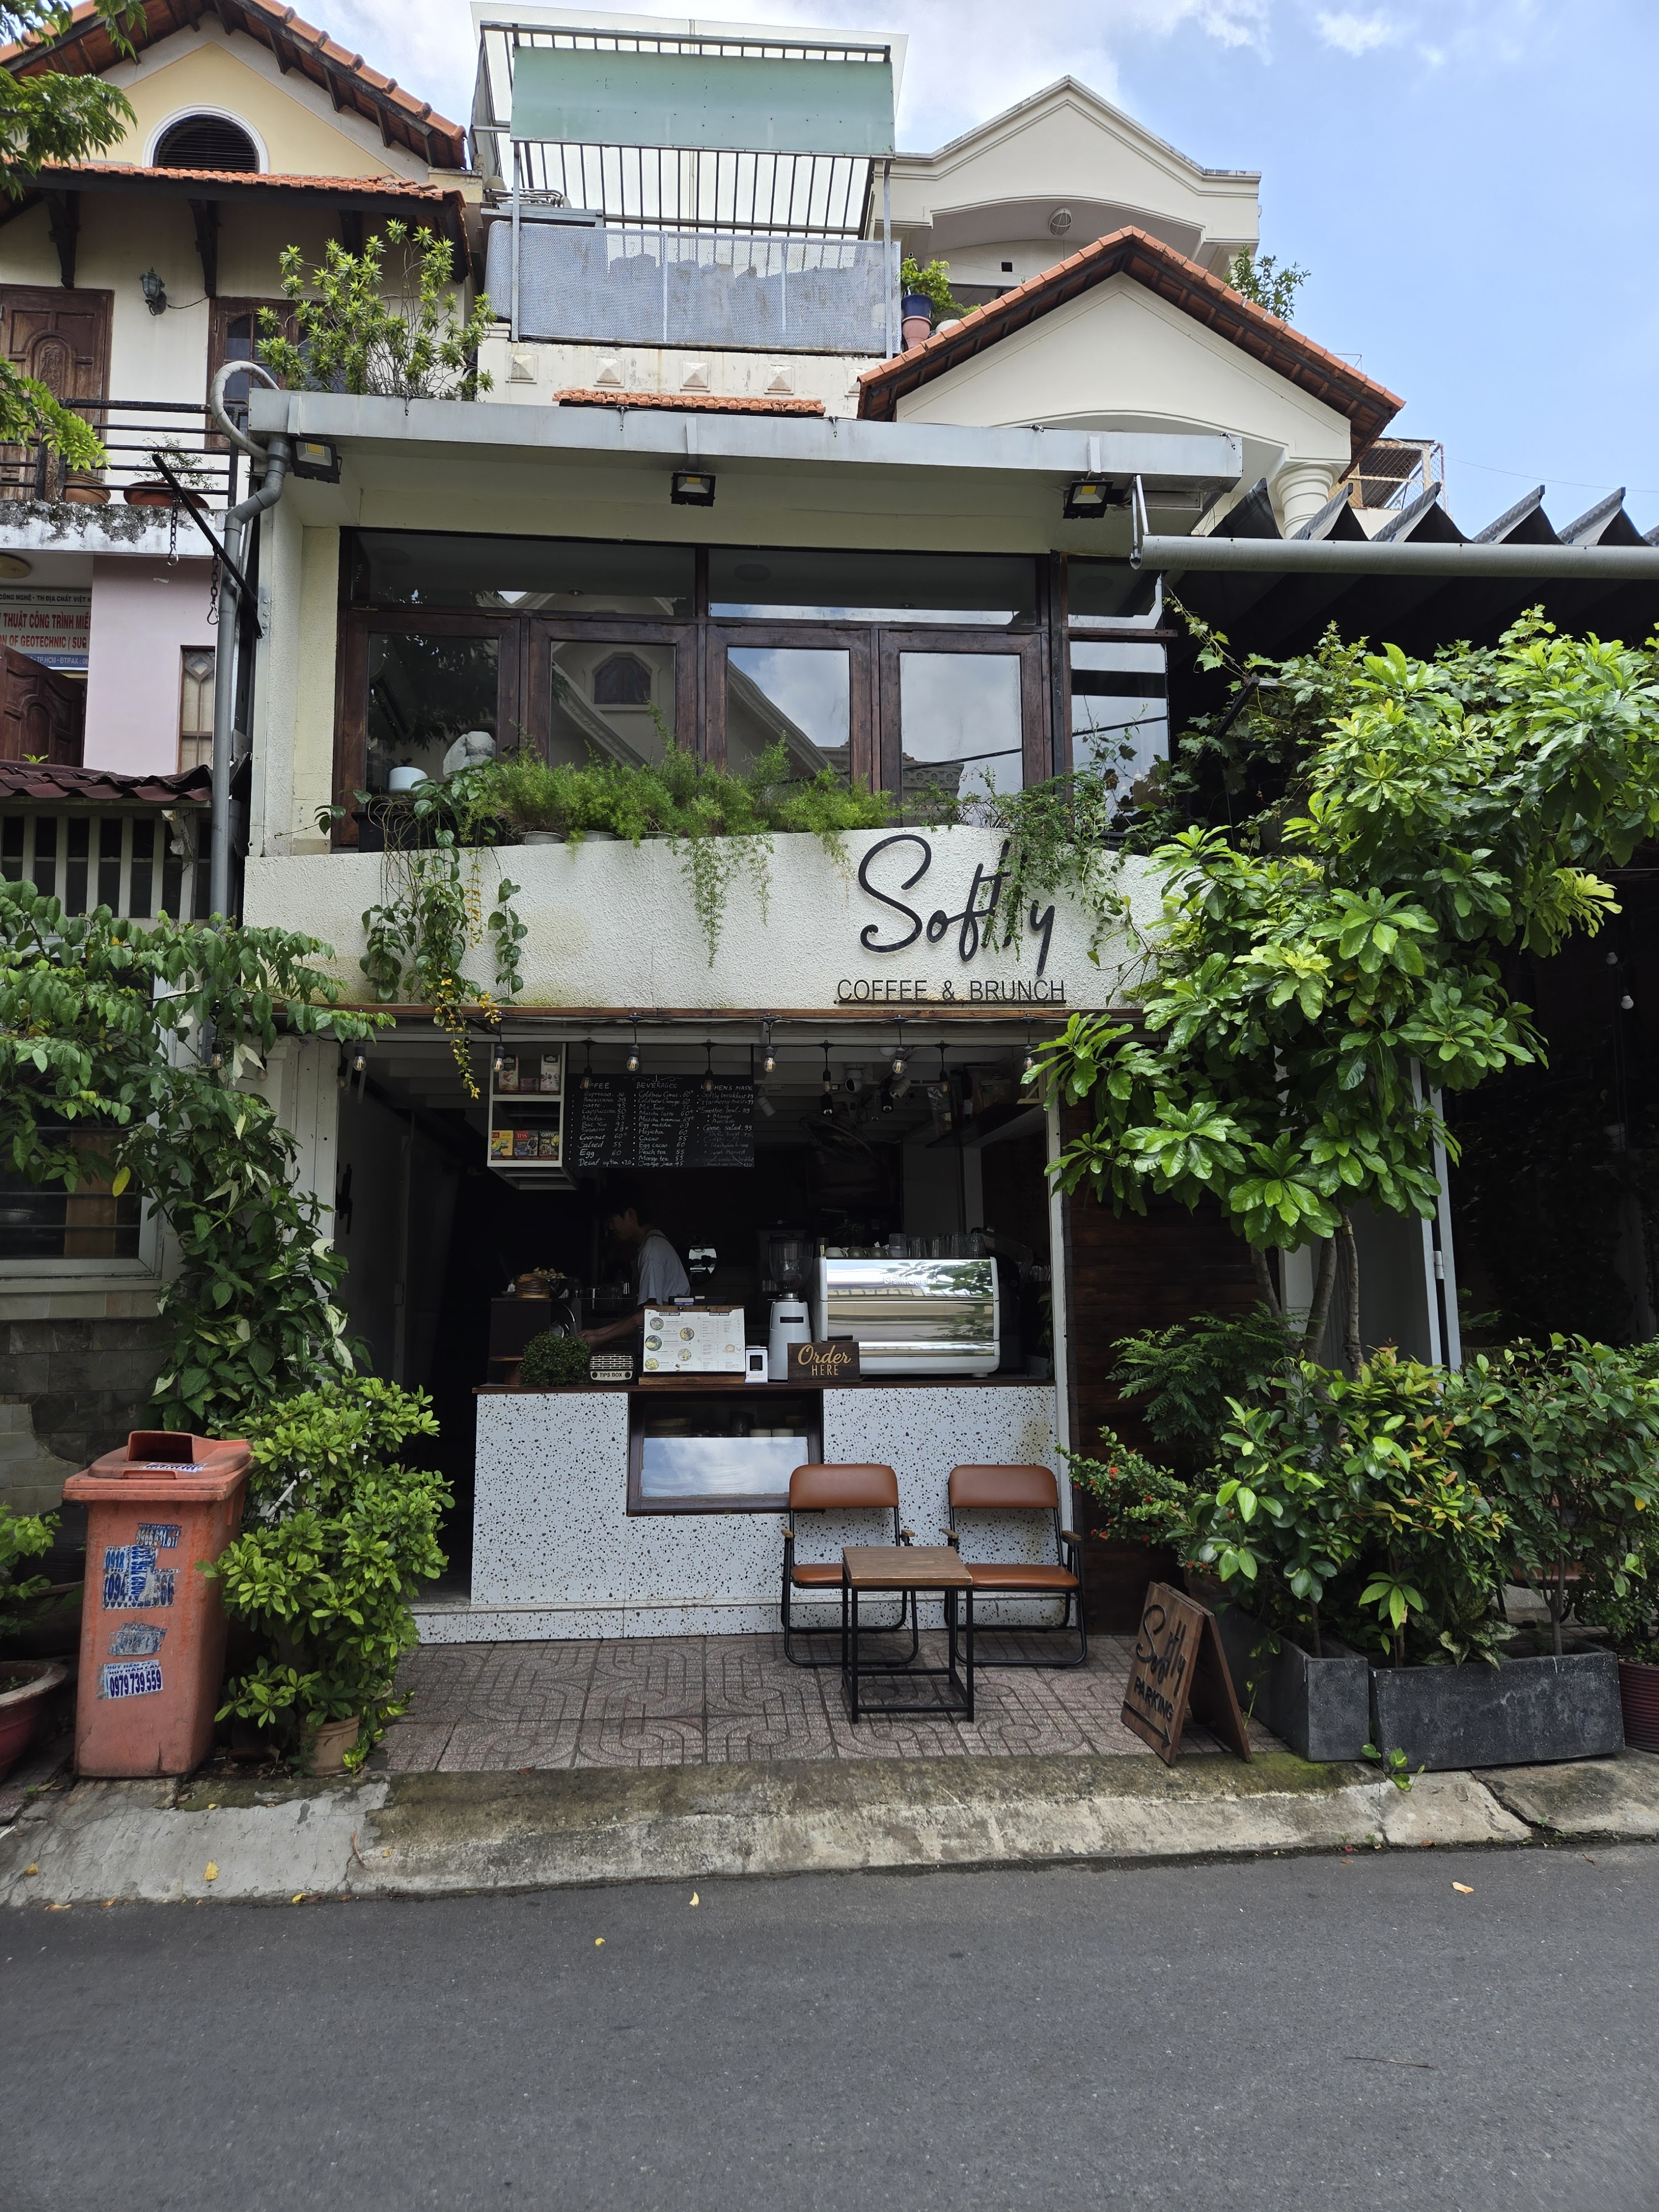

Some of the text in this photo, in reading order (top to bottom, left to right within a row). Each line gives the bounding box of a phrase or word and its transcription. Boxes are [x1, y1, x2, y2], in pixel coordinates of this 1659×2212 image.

[74, 595, 86, 603] VIỆT
[3, 610, 27, 630] THUẬT
[29, 611, 49, 629] CÔNG
[52, 611, 74, 629] TRÌNH
[9, 635, 18, 646] OF
[20, 635, 66, 648] GEOTECHNIC
[837, 979, 1065, 1001] COFFEE & BRUNCH
[580, 1148, 594, 1159] Egg
[639, 1141, 650, 1150] Egg
[578, 1157, 601, 1166] Decaf
[797, 1344, 852, 1365] Order
[812, 1364, 839, 1376] HERE
[1136, 1604, 1187, 1698] Softly
[109, 1669, 161, 1697] 0979.739.559
[1134, 1675, 1173, 1723] PARKING
